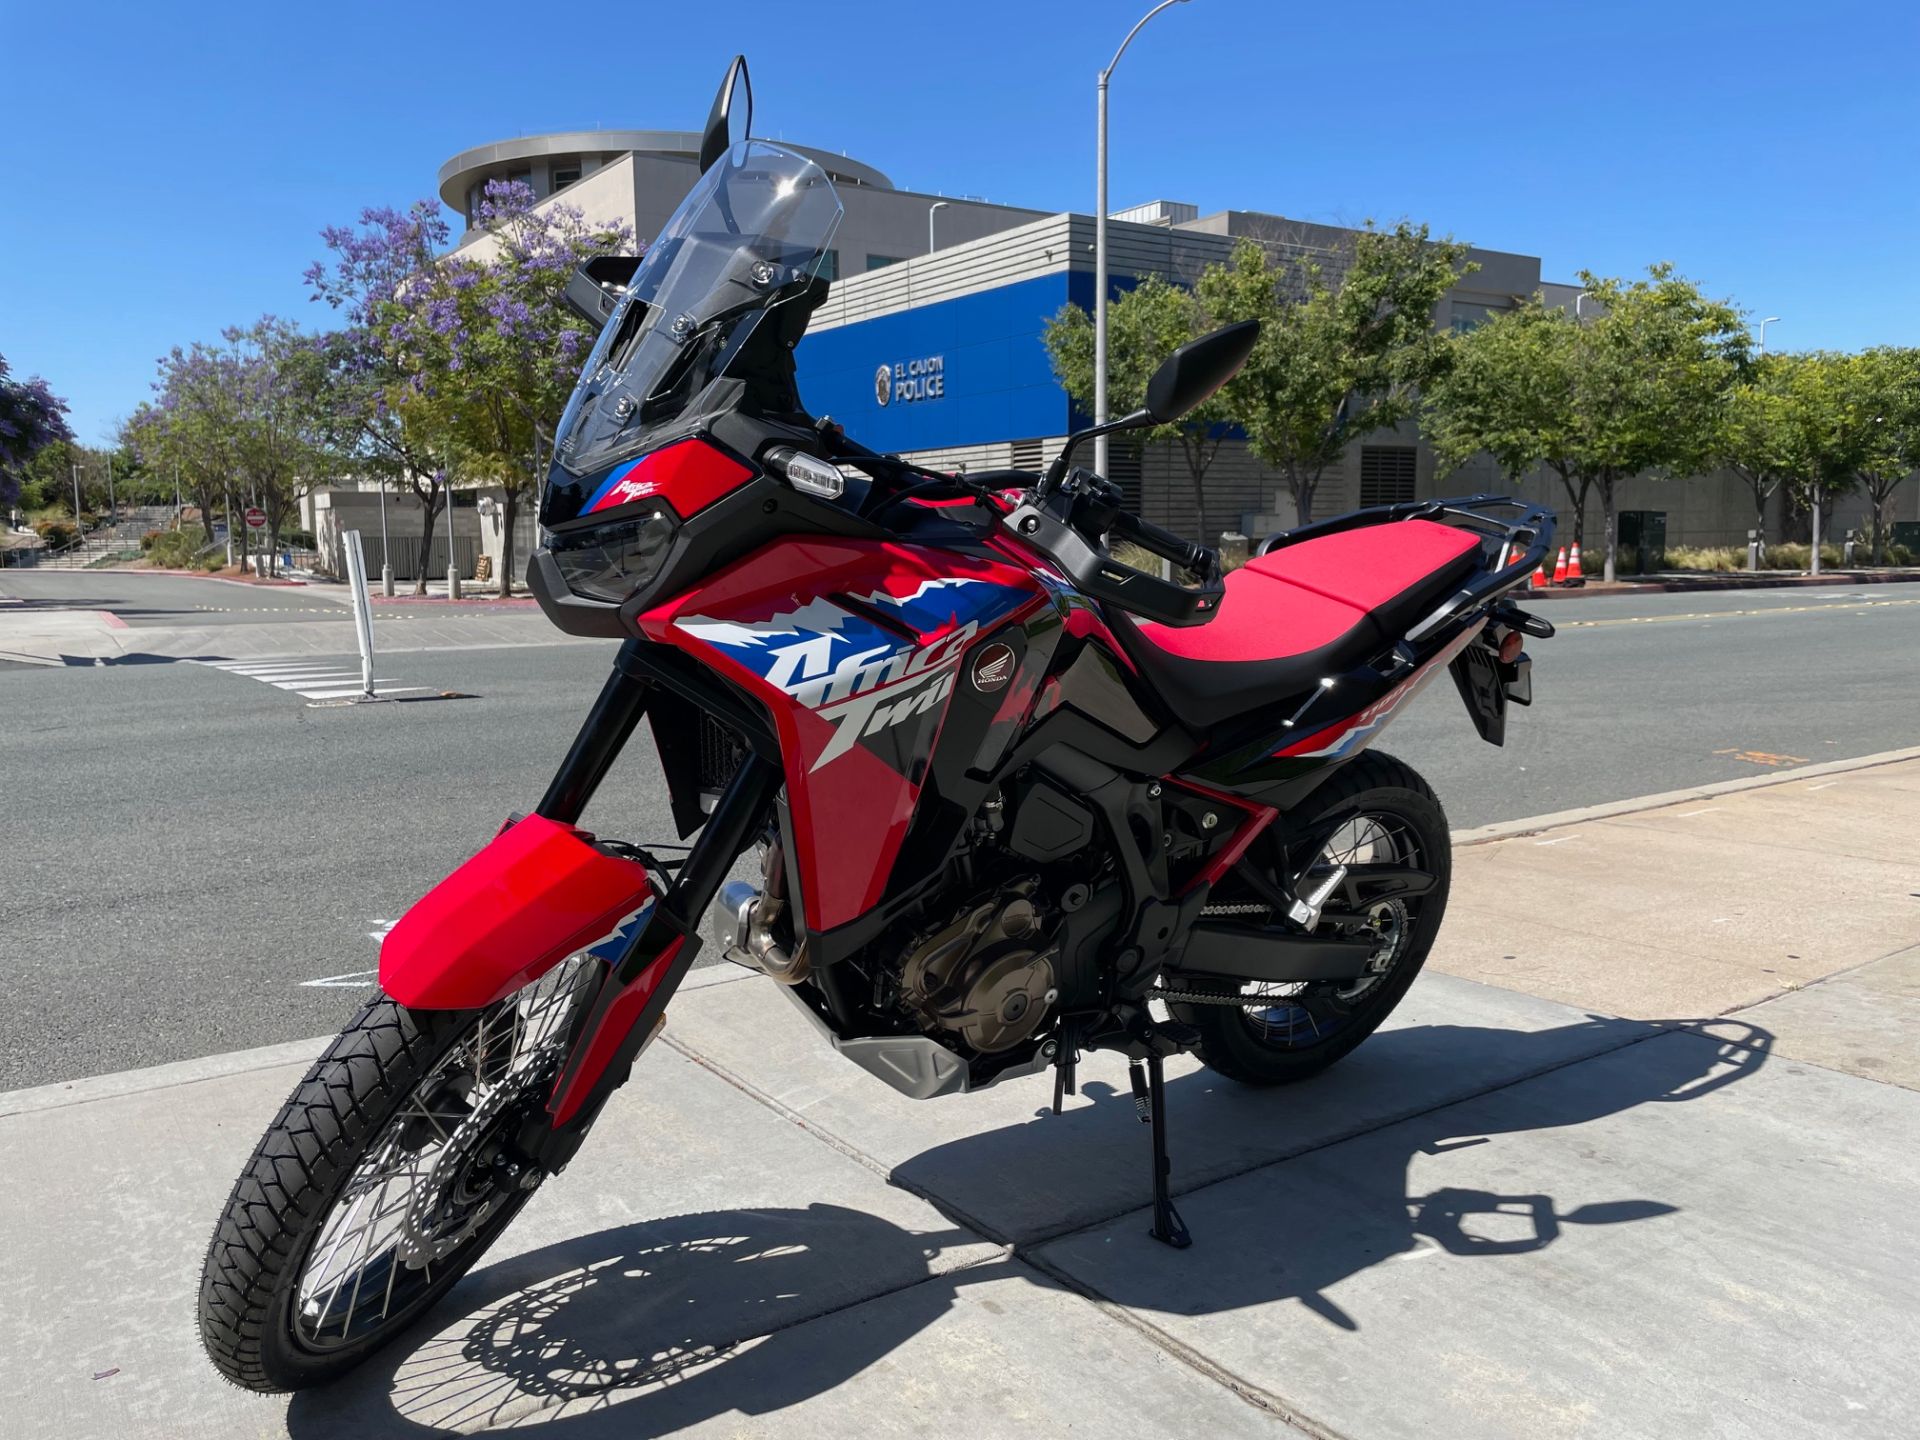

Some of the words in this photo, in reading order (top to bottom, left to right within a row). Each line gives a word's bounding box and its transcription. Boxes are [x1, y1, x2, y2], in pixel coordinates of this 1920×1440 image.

[895, 363, 906, 378] EL
[909, 355, 944, 376] CAJON
[895, 375, 944, 401] POLICE
[977, 675, 1007, 684] HONDA
